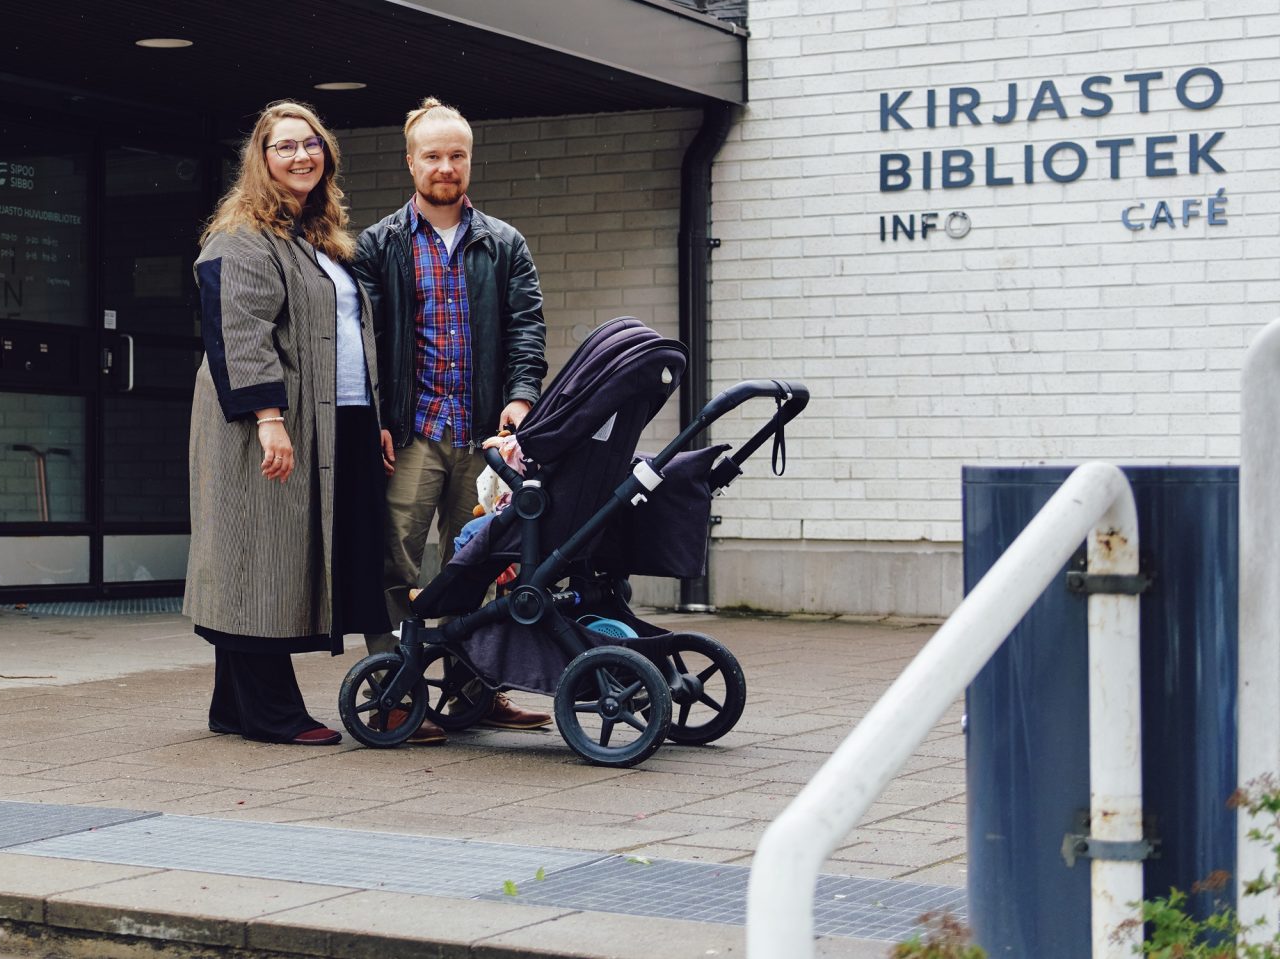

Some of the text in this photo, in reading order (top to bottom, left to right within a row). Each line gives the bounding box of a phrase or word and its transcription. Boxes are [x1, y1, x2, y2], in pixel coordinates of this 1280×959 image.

[879, 67, 1224, 131] KIRJASTO
[10, 163, 35, 177] SIPOO
[879, 132, 1226, 192] BIBLIOTEK
[10, 177, 34, 190] SIBBO
[24, 208, 82, 225] HUVUDBIBLIOTEK
[1121, 187, 1228, 231] CAFÉ
[879, 210, 972, 242] INFO
